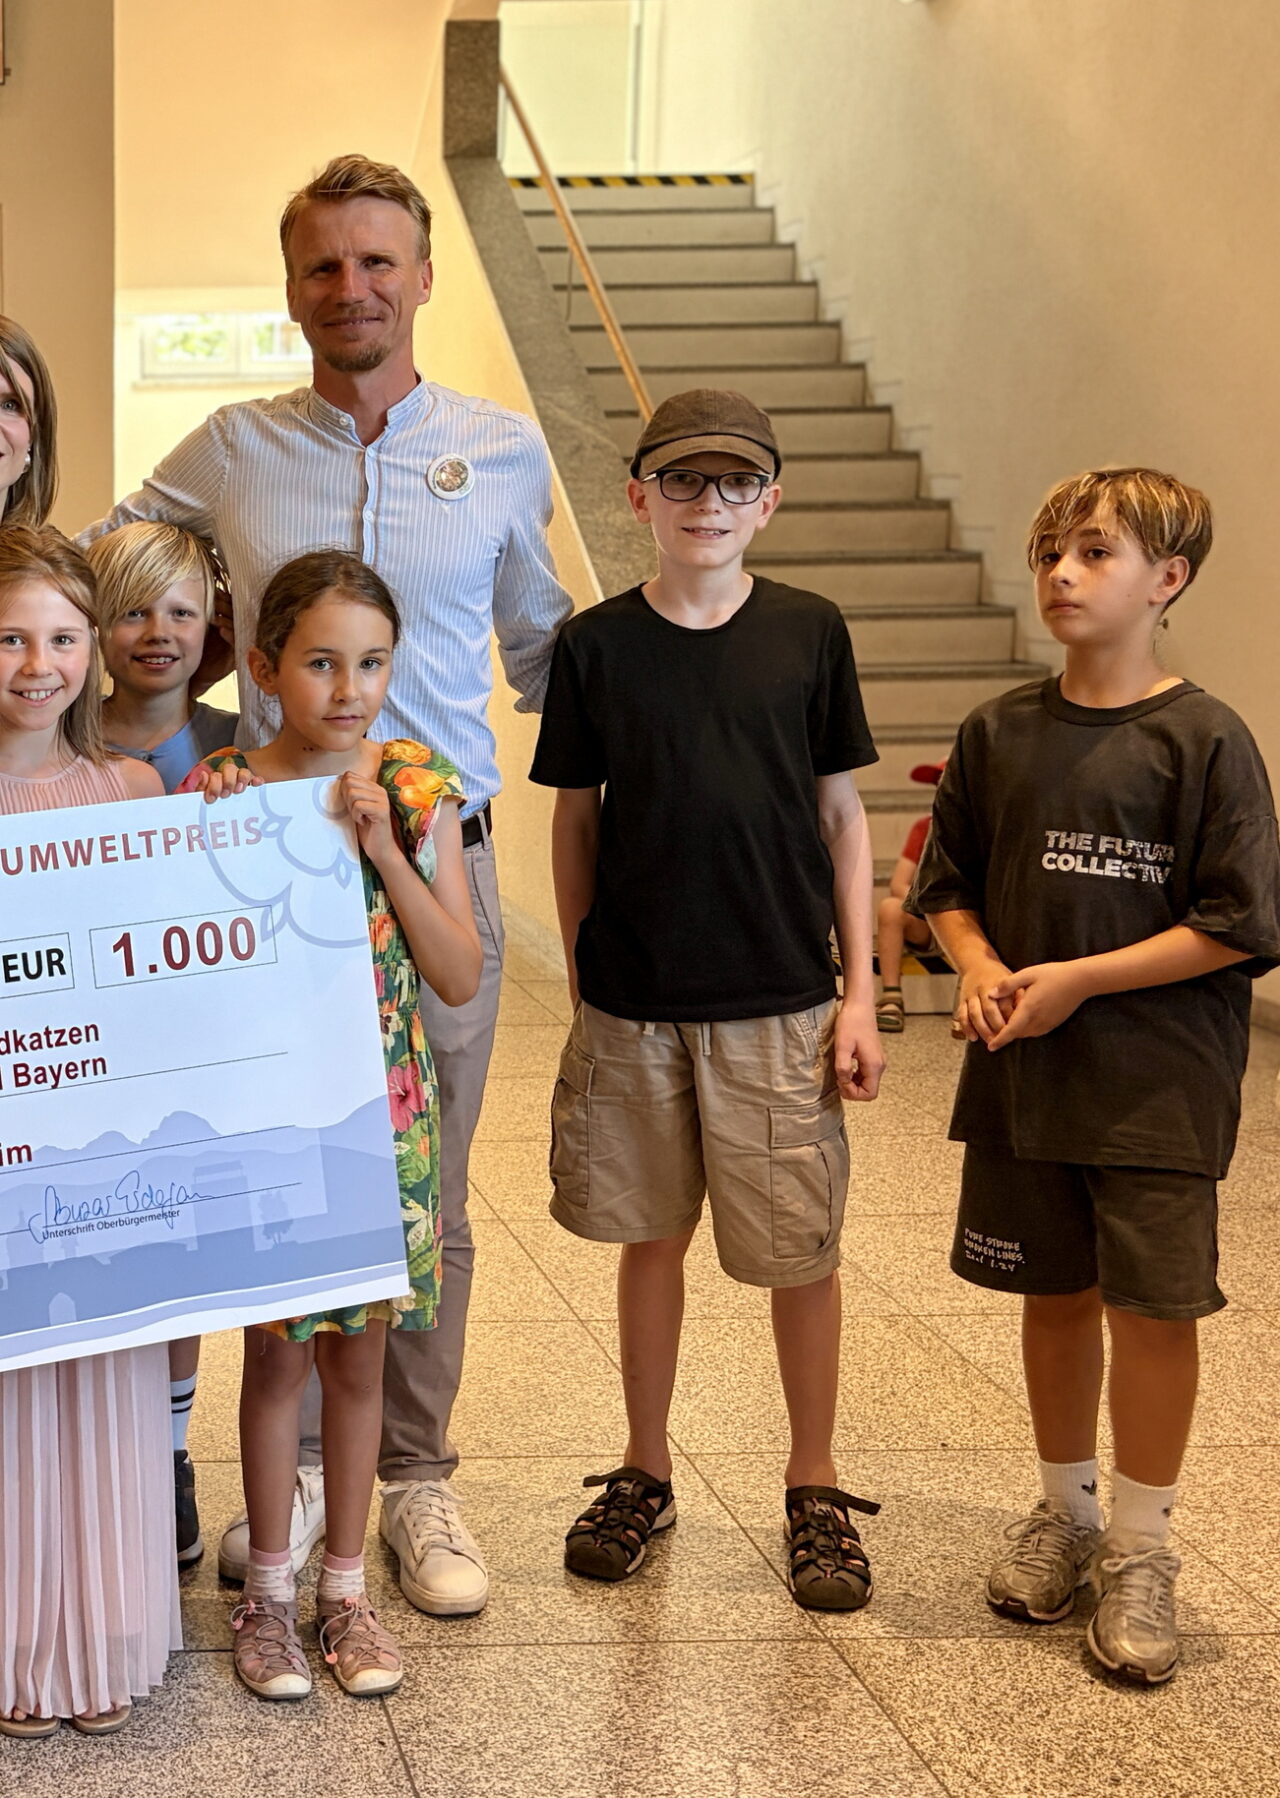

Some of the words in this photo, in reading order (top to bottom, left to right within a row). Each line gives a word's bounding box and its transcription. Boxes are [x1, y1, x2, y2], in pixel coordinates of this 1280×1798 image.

[0, 816, 263, 876] UMWELTPREIS
[1045, 830, 1094, 852] THE
[1098, 834, 1175, 863] FUTUR
[1041, 851, 1173, 884] COLLECTIV
[1, 946, 67, 984] EUR
[111, 916, 257, 978] 1.000
[13, 1056, 108, 1090] Bayern
[42, 1220, 95, 1240] Unterschrift
[96, 1208, 180, 1231] Oberbürgermeister
